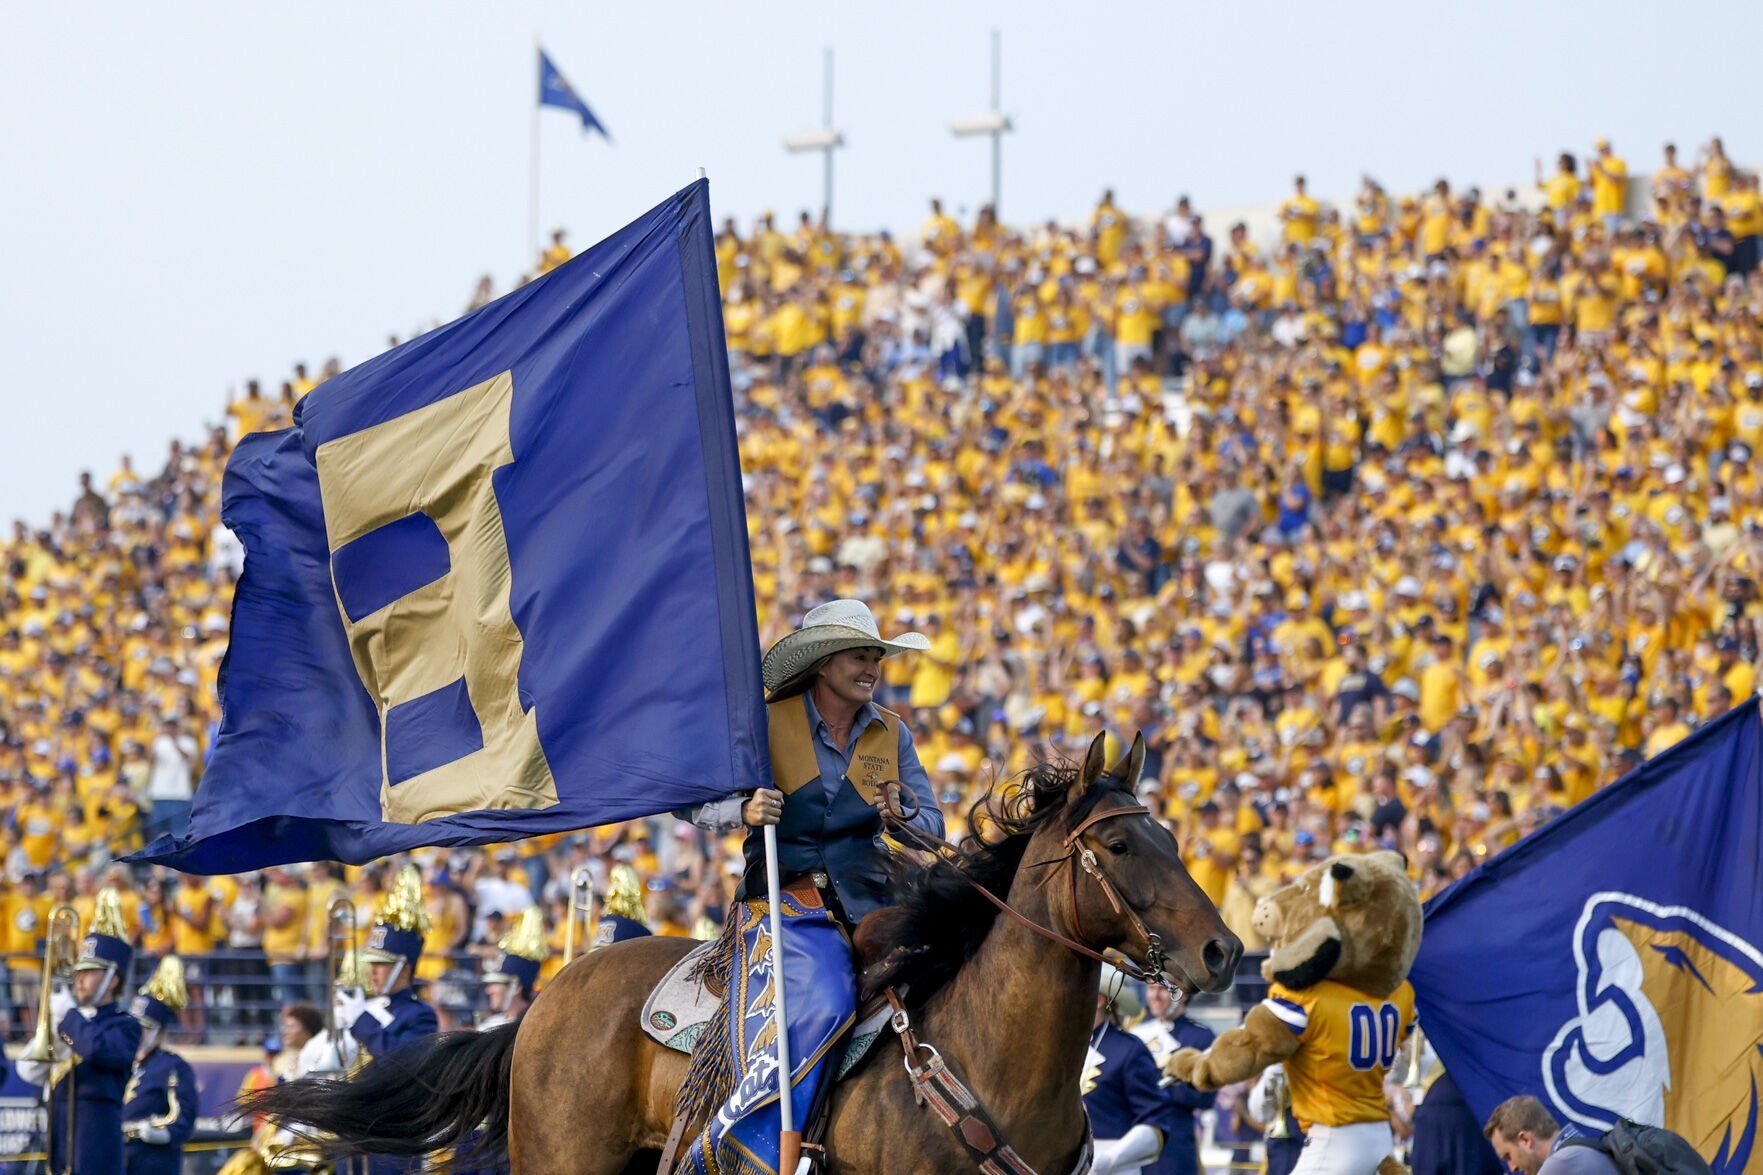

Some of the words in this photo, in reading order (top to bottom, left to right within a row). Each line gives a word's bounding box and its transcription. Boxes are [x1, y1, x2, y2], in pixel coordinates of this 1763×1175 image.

[857, 754, 890, 765] MONTANA
[863, 762, 884, 772] STATE
[1348, 1001, 1399, 1071] 00
